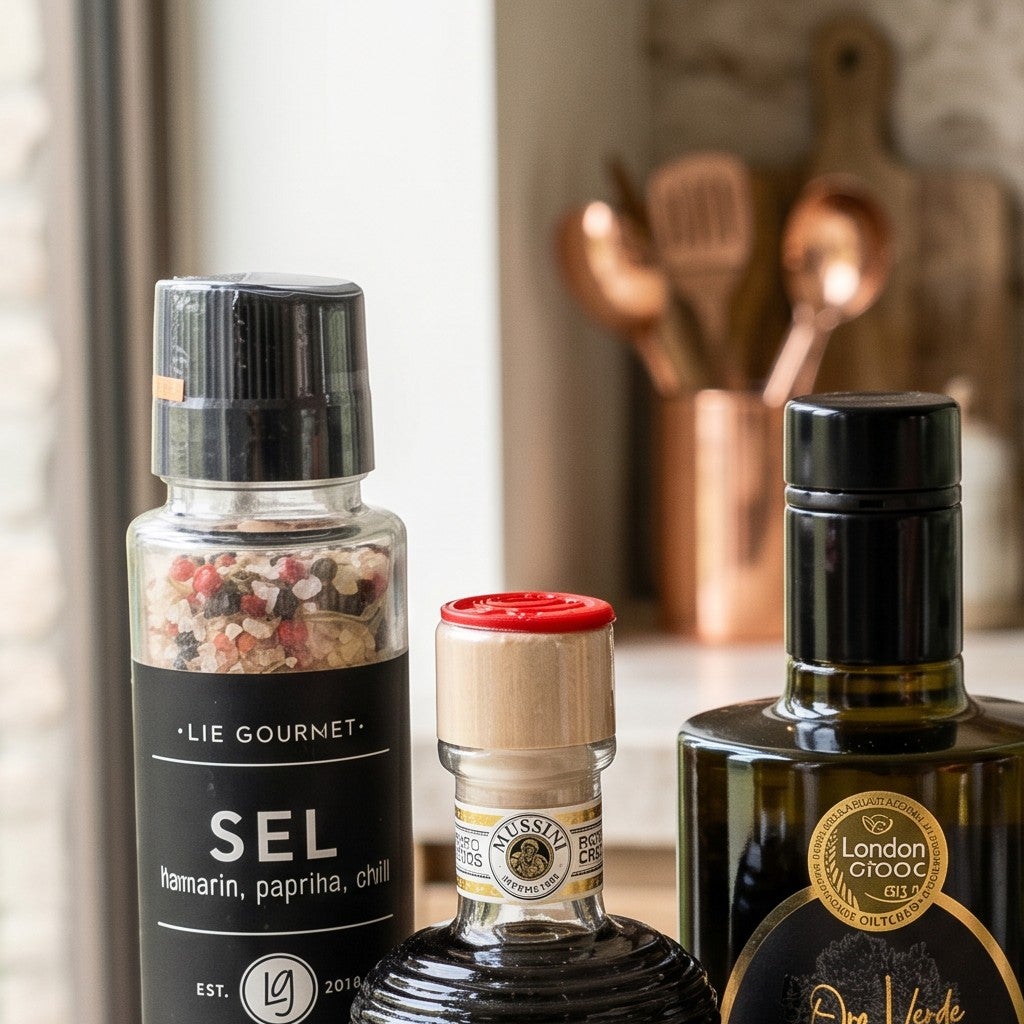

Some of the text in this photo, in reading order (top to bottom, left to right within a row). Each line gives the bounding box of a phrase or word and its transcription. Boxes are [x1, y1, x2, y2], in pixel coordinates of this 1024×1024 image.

[209, 809, 338, 863] SEL
[493, 819, 568, 853] MUSSINI
[842, 836, 926, 858] London
[196, 982, 229, 998] EST.
